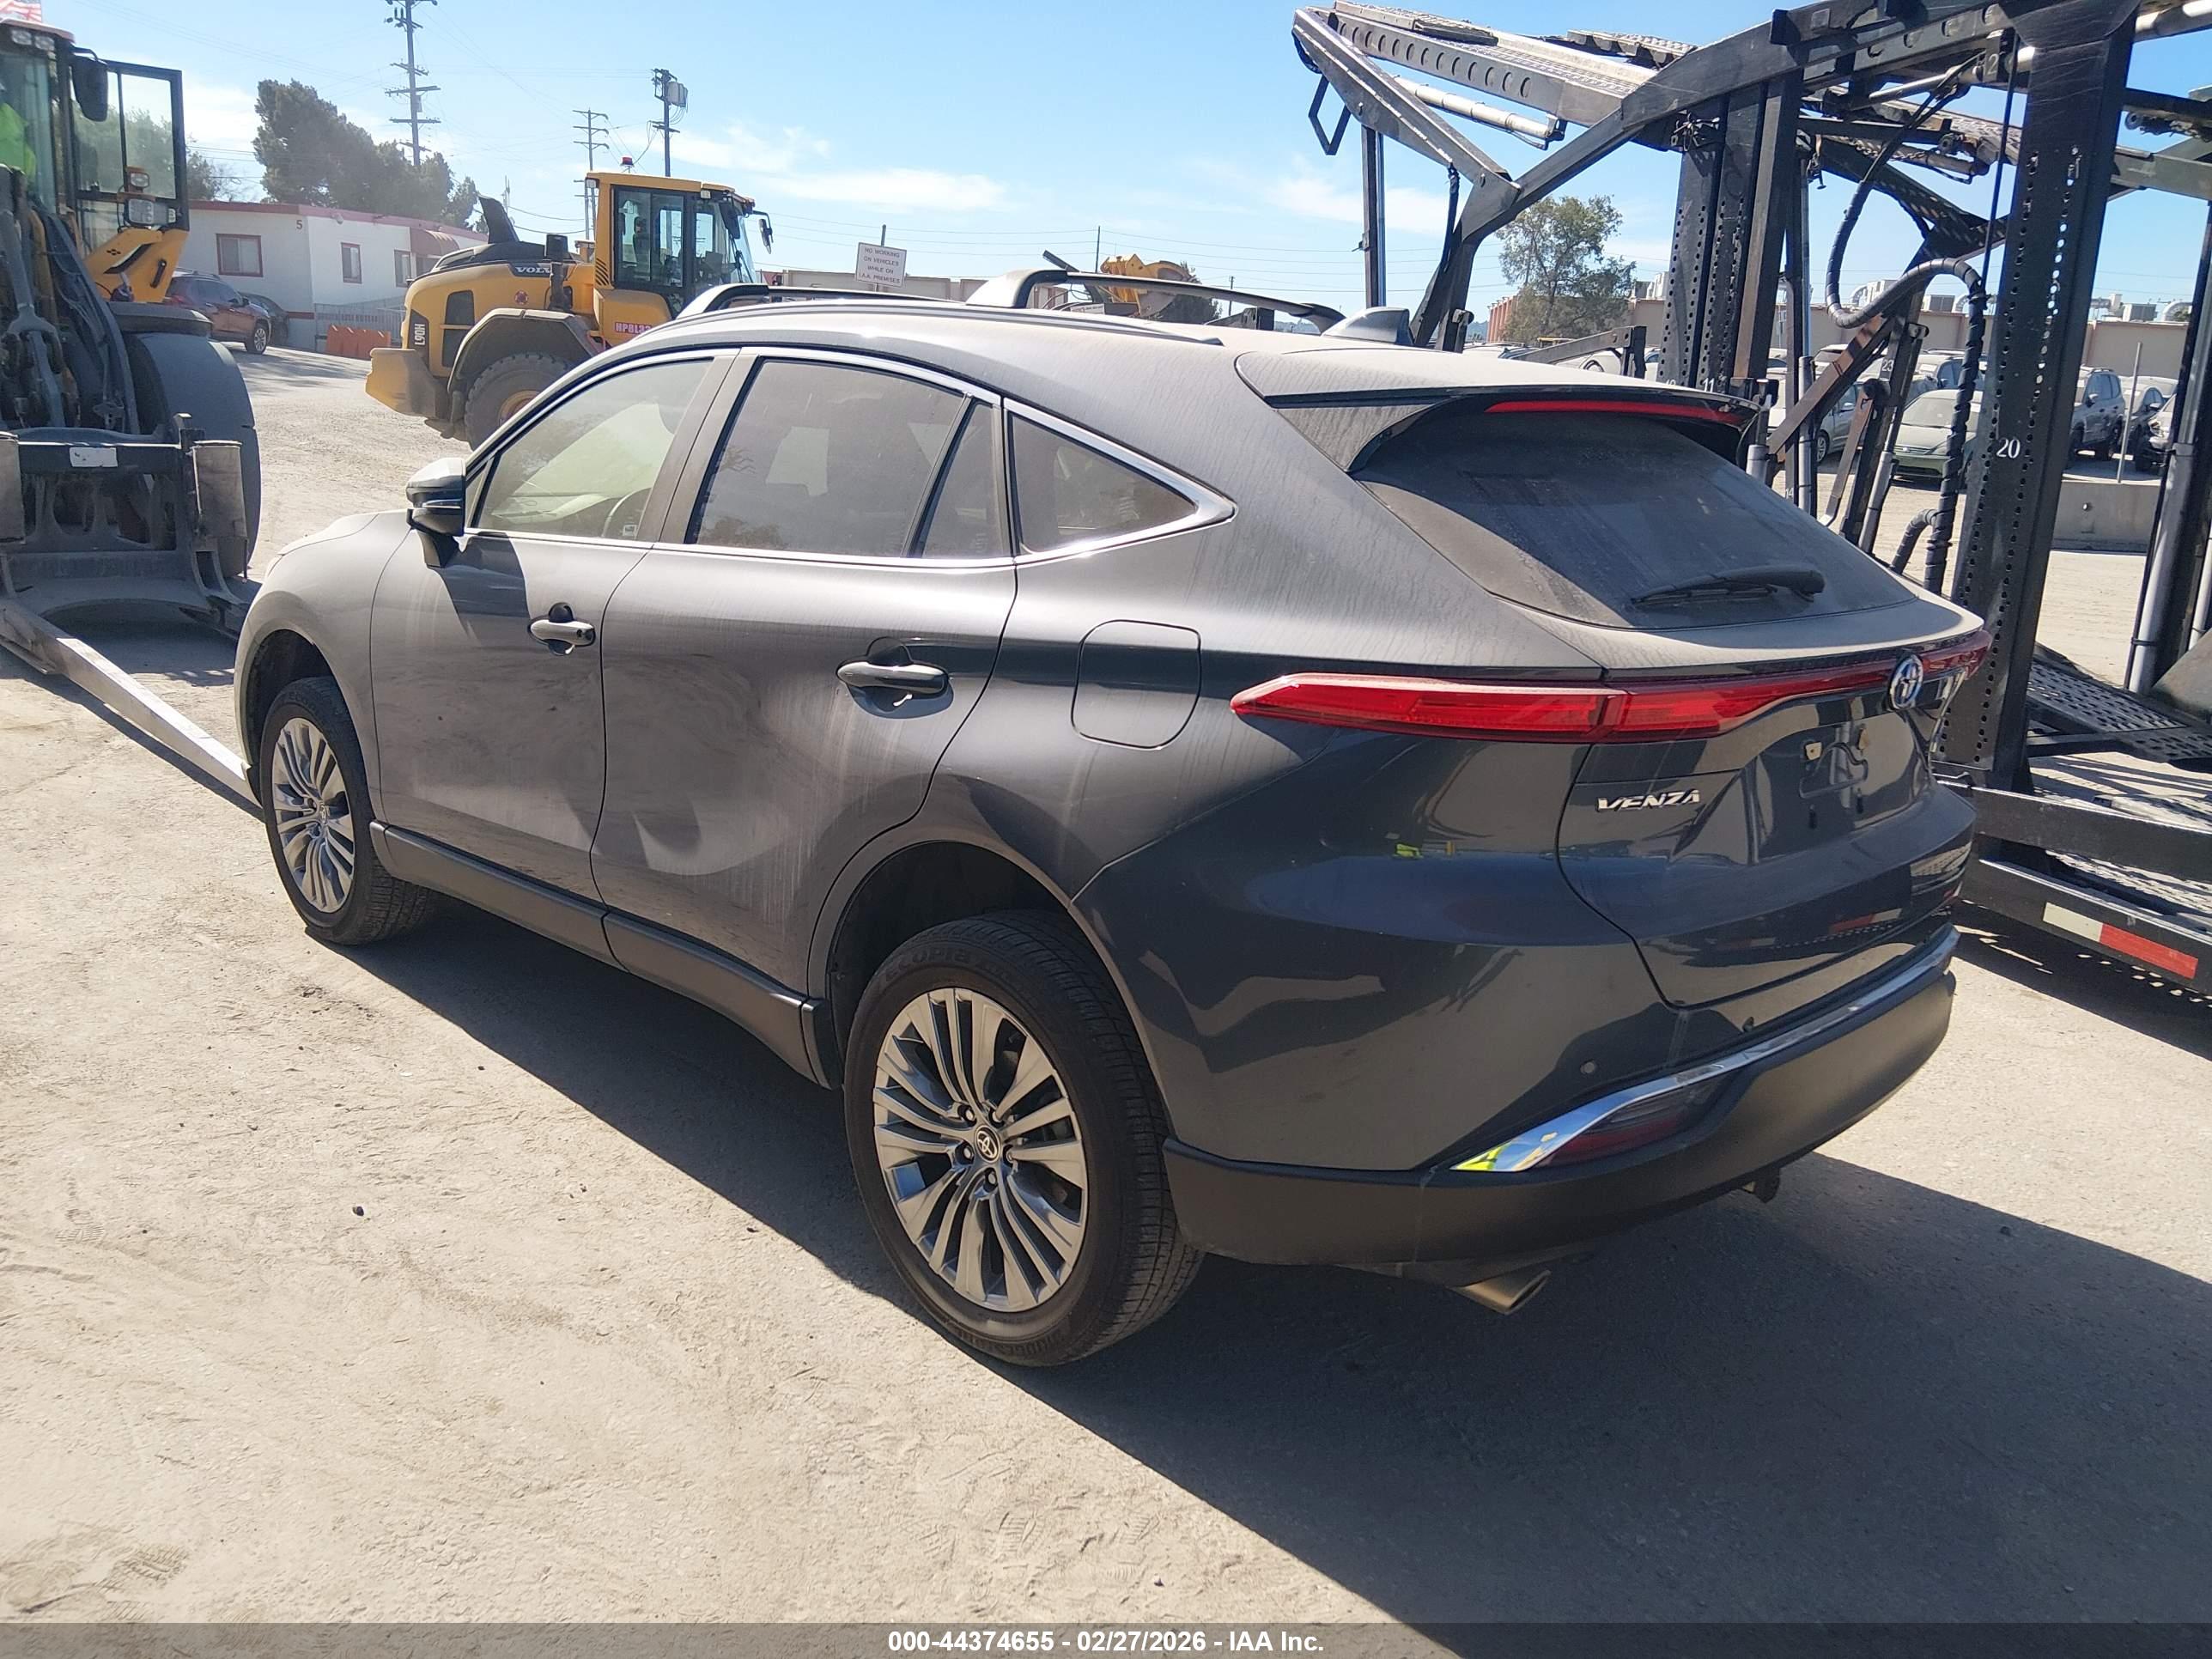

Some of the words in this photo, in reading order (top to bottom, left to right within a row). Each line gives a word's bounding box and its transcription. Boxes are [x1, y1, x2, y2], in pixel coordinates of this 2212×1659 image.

[1988, 53, 1999, 75] 2
[296, 219, 303, 230] 5
[875, 249, 900, 258] WORKING
[874, 258, 899, 266] VEHICLES
[873, 275, 901, 283] PREMISES
[414, 323, 426, 345] L90H
[1881, 359, 1894, 371] 23
[1703, 378, 1715, 392] 11
[1996, 439, 2021, 459] 20
[1596, 789, 1700, 811] VENZA
